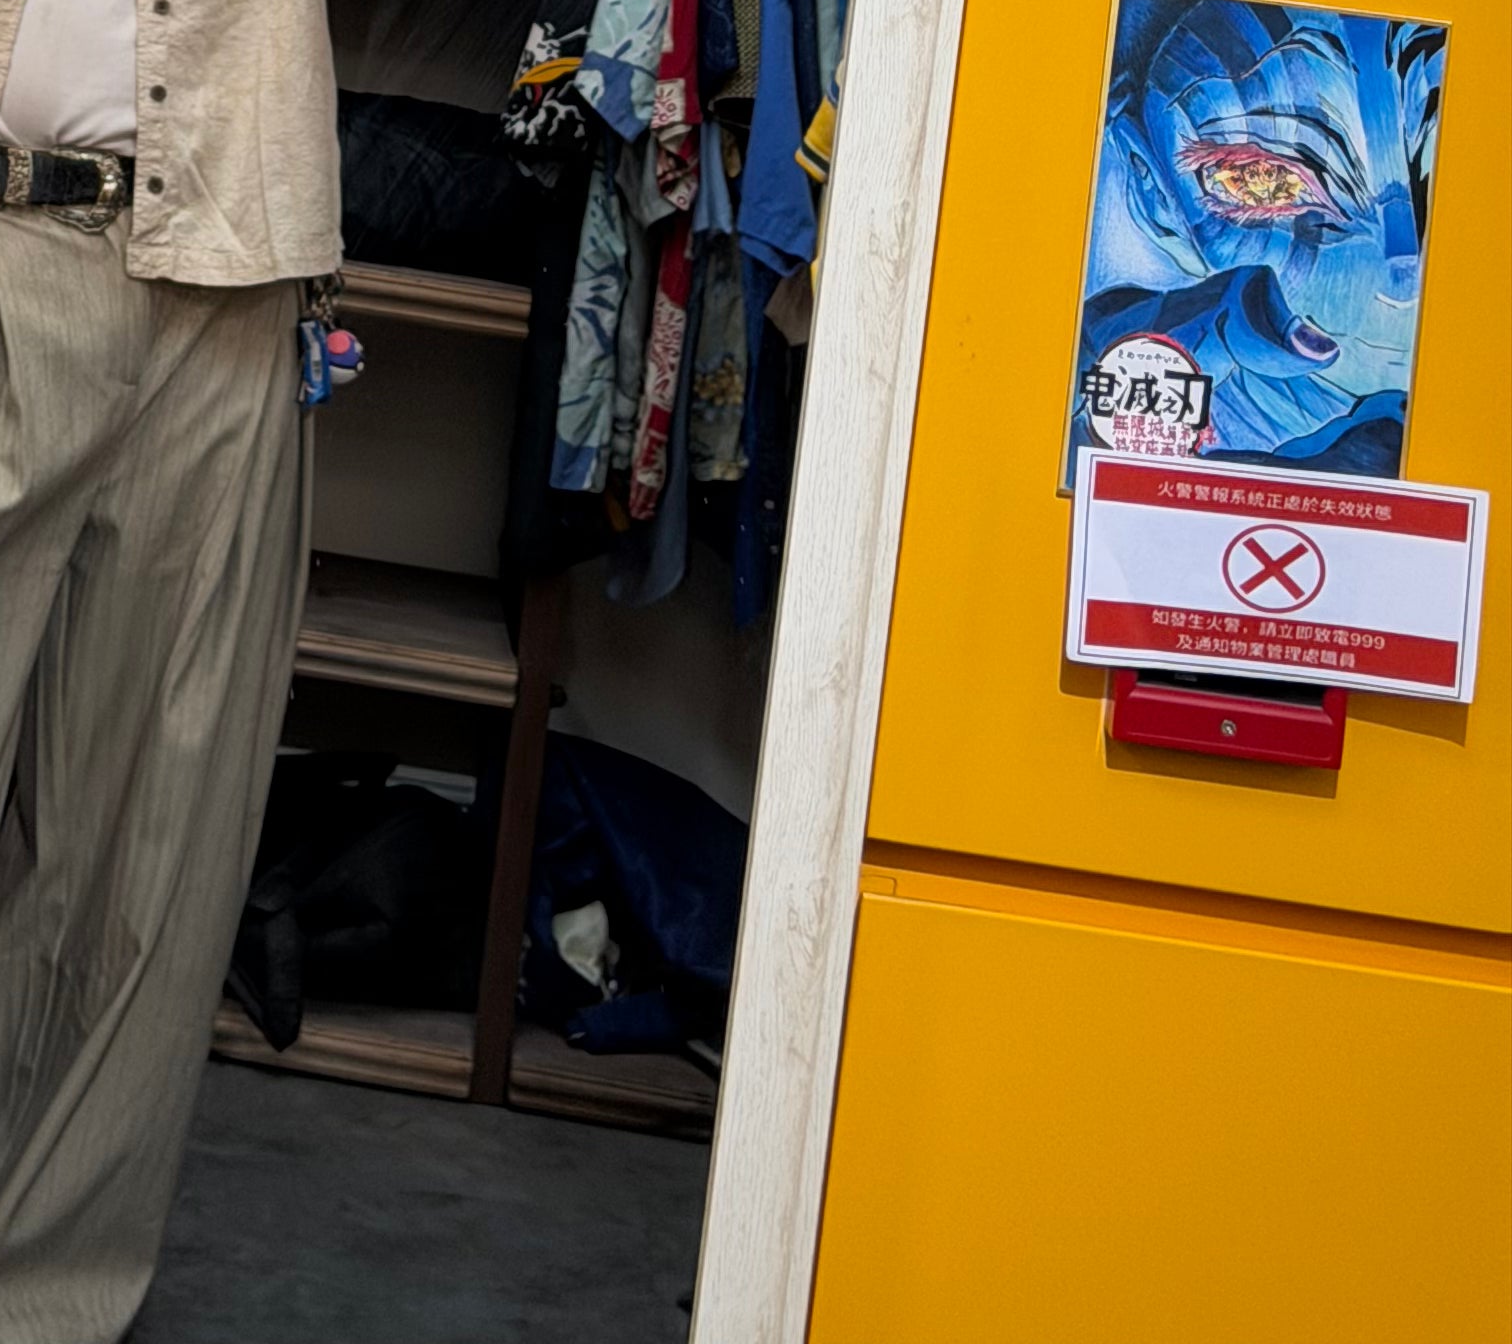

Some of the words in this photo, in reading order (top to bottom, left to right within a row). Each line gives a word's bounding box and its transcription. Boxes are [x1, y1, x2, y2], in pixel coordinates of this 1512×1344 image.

[1157, 480, 1393, 521] 火警警報系統正處於失效狀態
[1175, 633, 1357, 670] 及通知物業管理處職員
